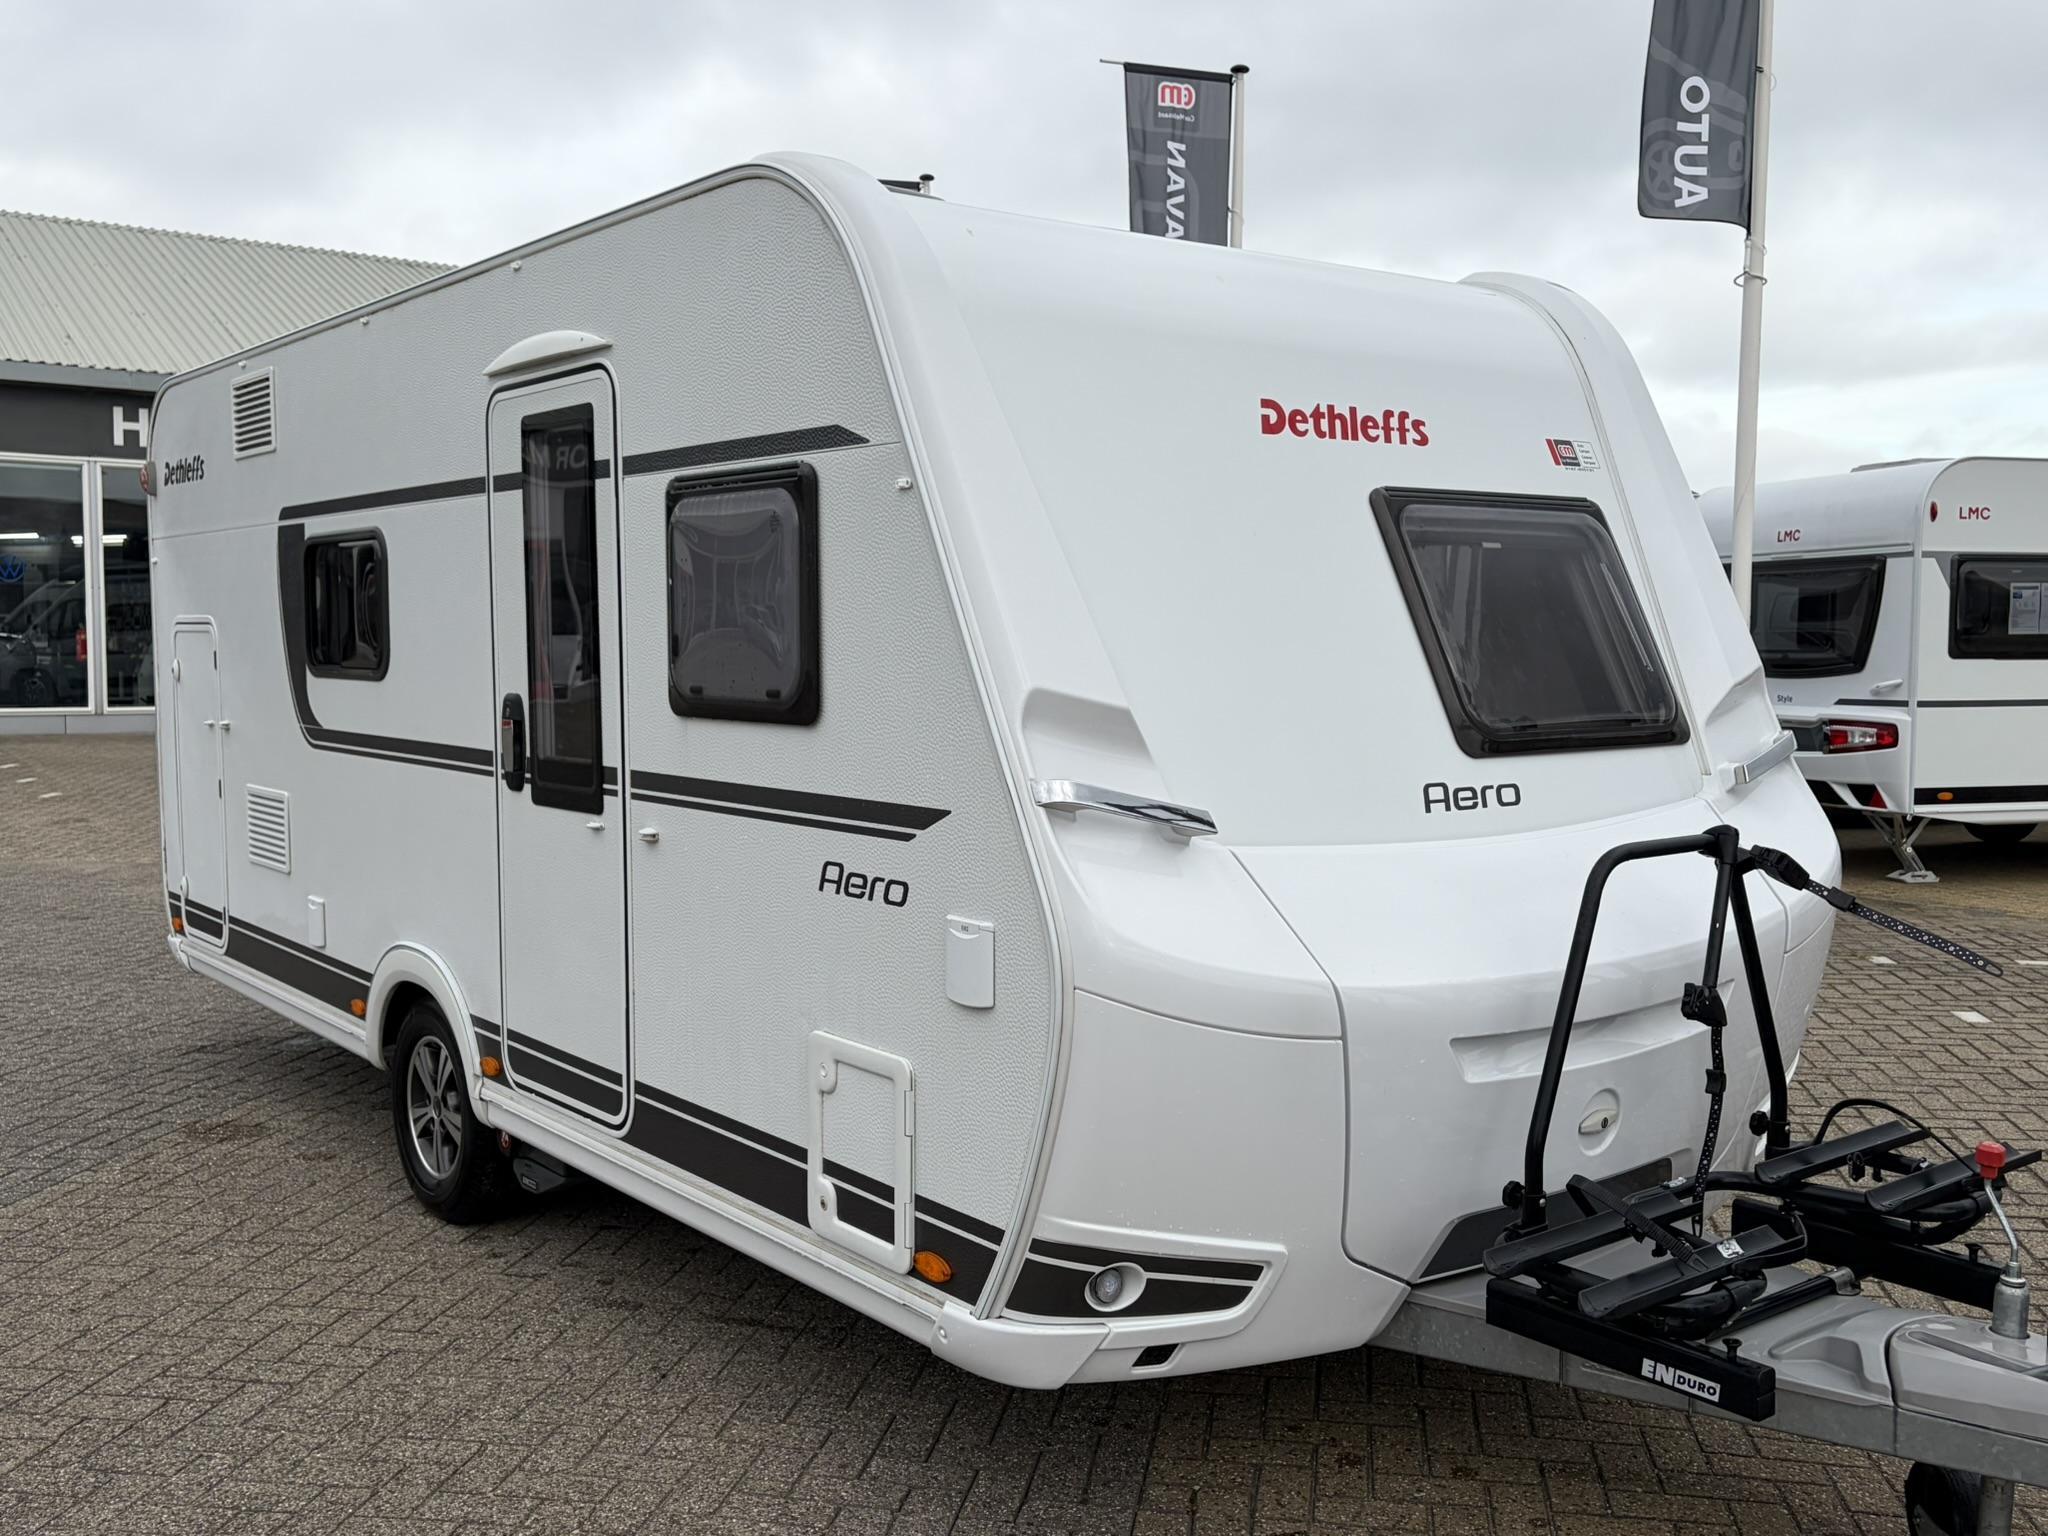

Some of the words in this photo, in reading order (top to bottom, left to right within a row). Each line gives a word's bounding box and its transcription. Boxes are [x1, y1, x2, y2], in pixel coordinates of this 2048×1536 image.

[1260, 398, 1429, 447] Dethleffs
[164, 455, 204, 487] Dethleffs
[1958, 507, 1991, 520] LMC
[1777, 529, 1801, 542] LMC
[1423, 782, 1521, 813] Aero
[818, 860, 909, 907] Aero
